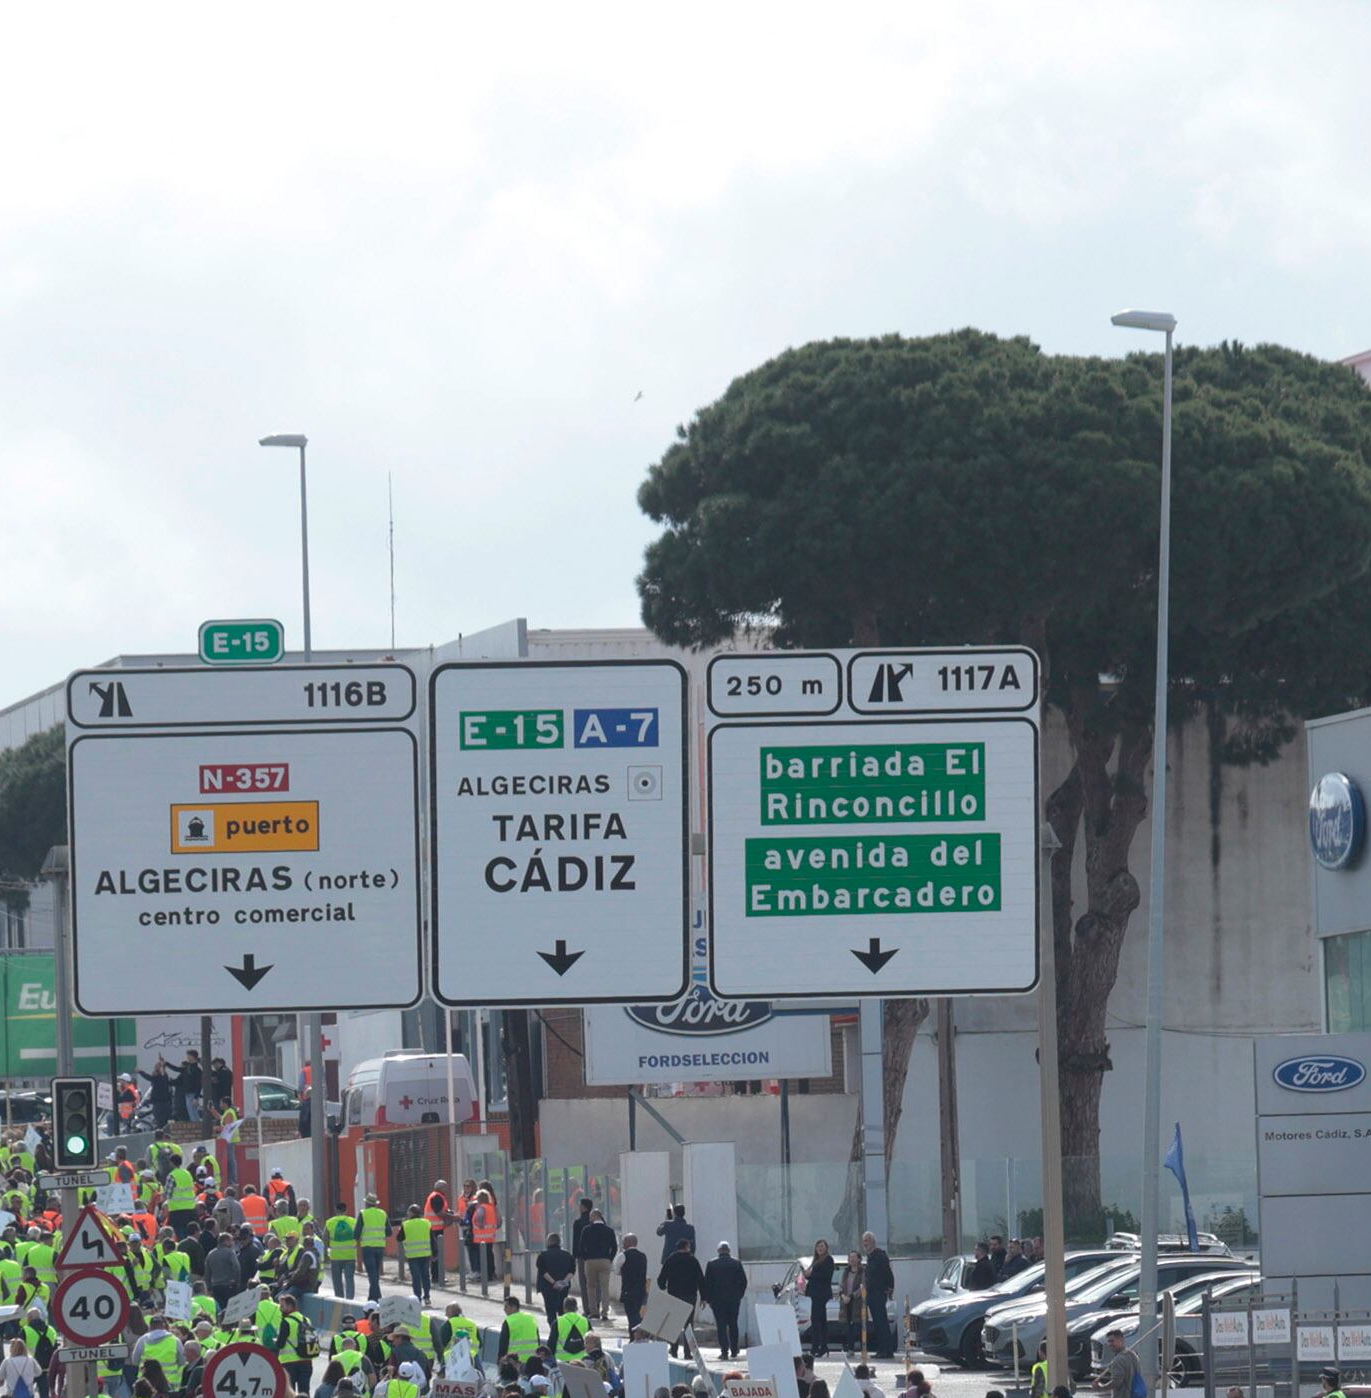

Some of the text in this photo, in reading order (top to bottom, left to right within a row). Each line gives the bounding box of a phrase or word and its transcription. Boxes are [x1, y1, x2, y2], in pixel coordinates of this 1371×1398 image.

[212, 631, 271, 653] E-15
[727, 675, 824, 697] 250 m
[937, 664, 1022, 691] 1117A
[303, 681, 387, 707] 1116B
[463, 712, 655, 746] E-15 A-7
[765, 748, 980, 780] barriada El
[202, 766, 286, 791] N-357
[457, 774, 611, 797] ALGECIRAS
[767, 790, 978, 820] Rinconcillo
[226, 815, 310, 840] puerto
[492, 812, 628, 842] TARIFA
[763, 840, 983, 871] avenida del
[94, 866, 400, 895] ALGECIRAS (norte)
[484, 848, 636, 893] CÁDIZ
[751, 881, 995, 912] Embarcadero
[138, 902, 356, 926] centro comercial
[638, 1051, 770, 1069] FORDSELECCION
[1293, 1061, 1349, 1086] Ford
[417, 1096, 439, 1105] Cruz
[1265, 1131, 1312, 1142] Motores
[55, 1175, 94, 1186] TUNEL
[69, 1294, 115, 1321] 40
[70, 1349, 115, 1360] TUNEL
[731, 1387, 773, 1397] BAJADA
